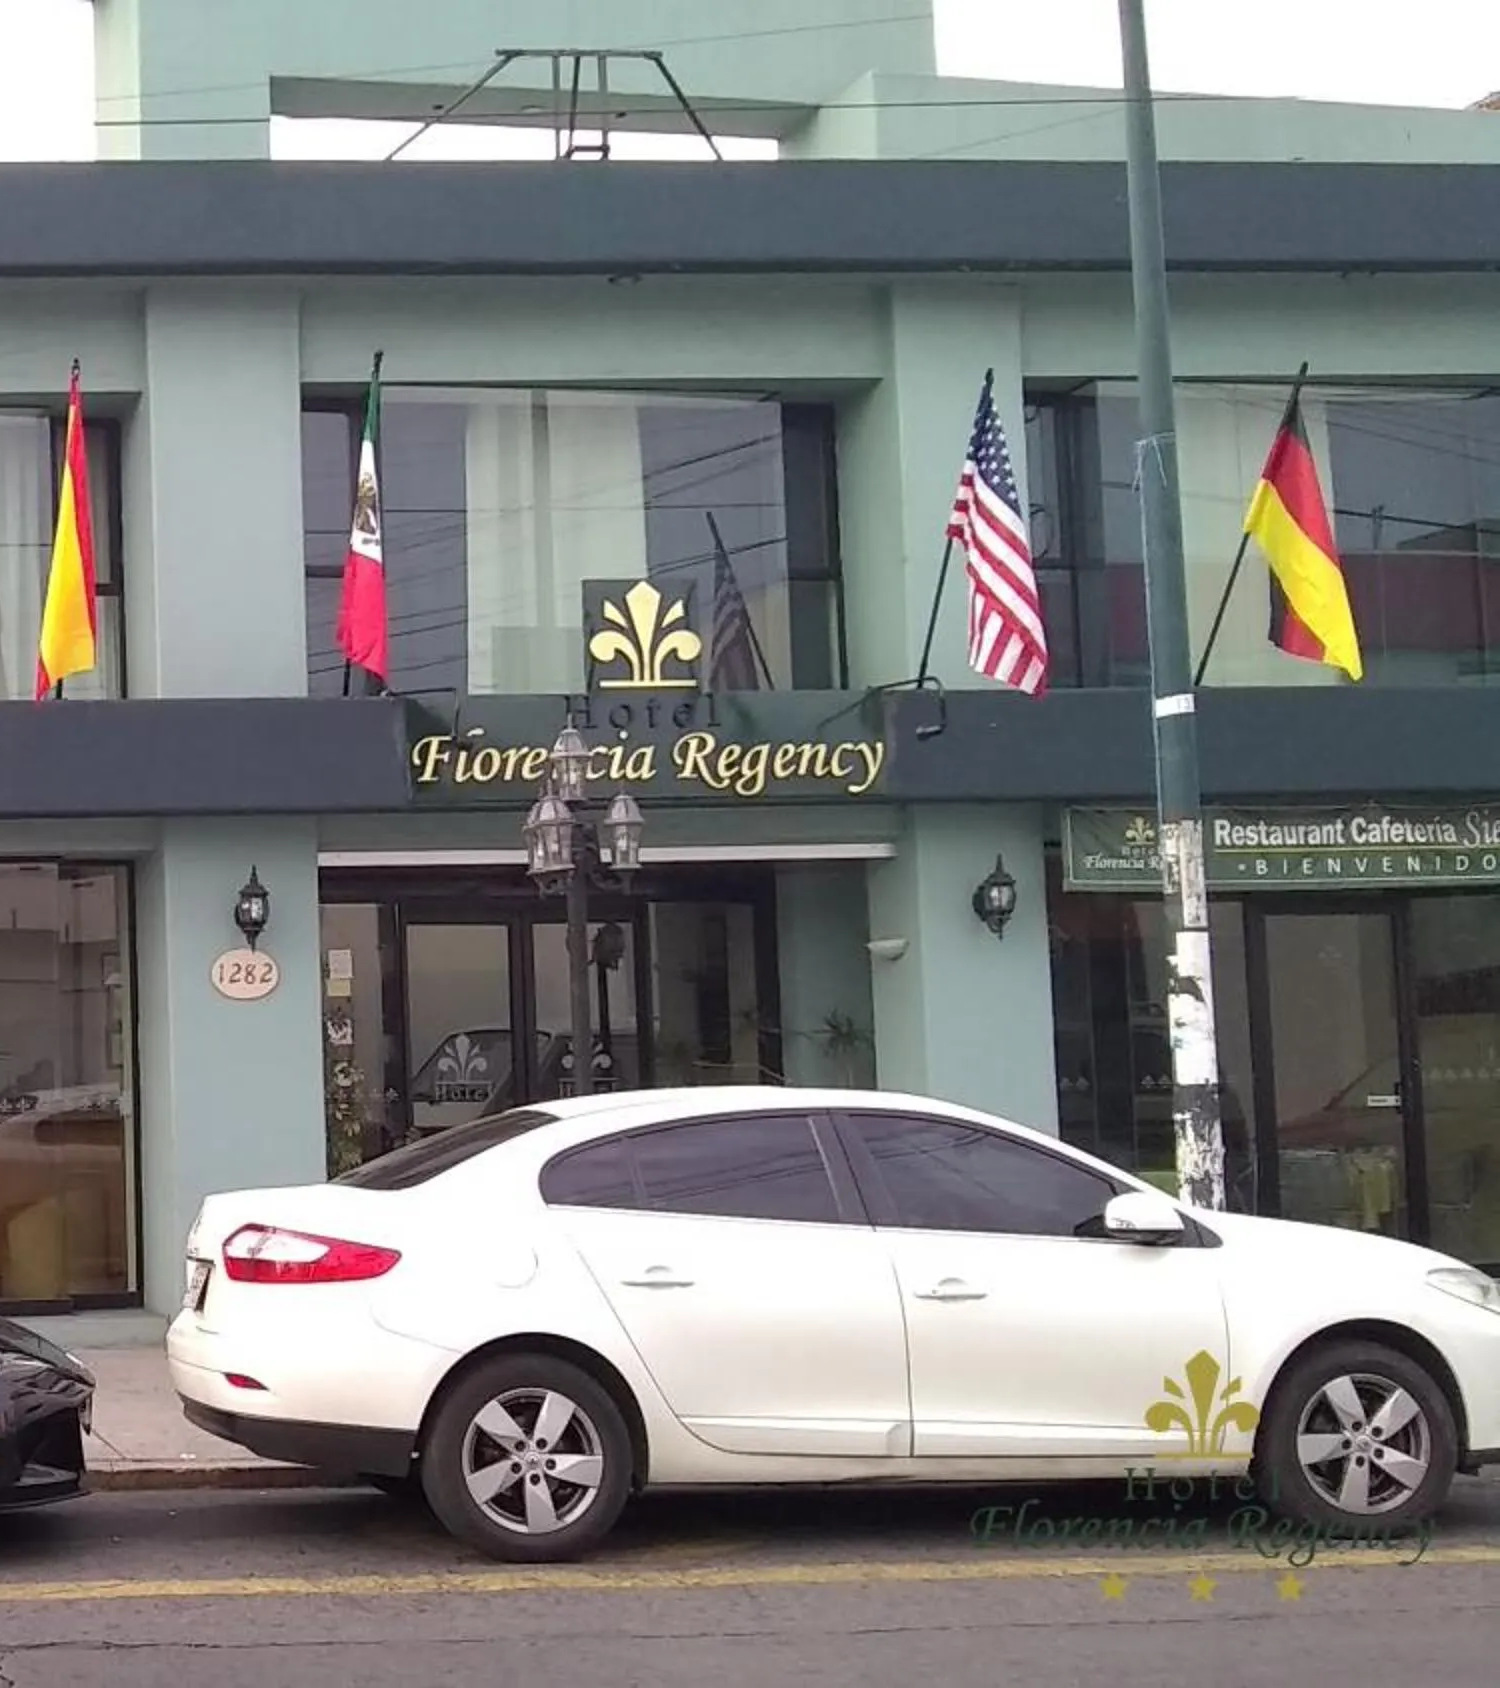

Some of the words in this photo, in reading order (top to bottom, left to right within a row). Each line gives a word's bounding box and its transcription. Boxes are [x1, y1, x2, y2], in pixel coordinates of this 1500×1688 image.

[565, 694, 722, 729] Hotel
[672, 731, 885, 797] Regency
[1214, 818, 1346, 846] Restaurant
[1351, 815, 1458, 843] Cafetería
[218, 962, 273, 985] 1282
